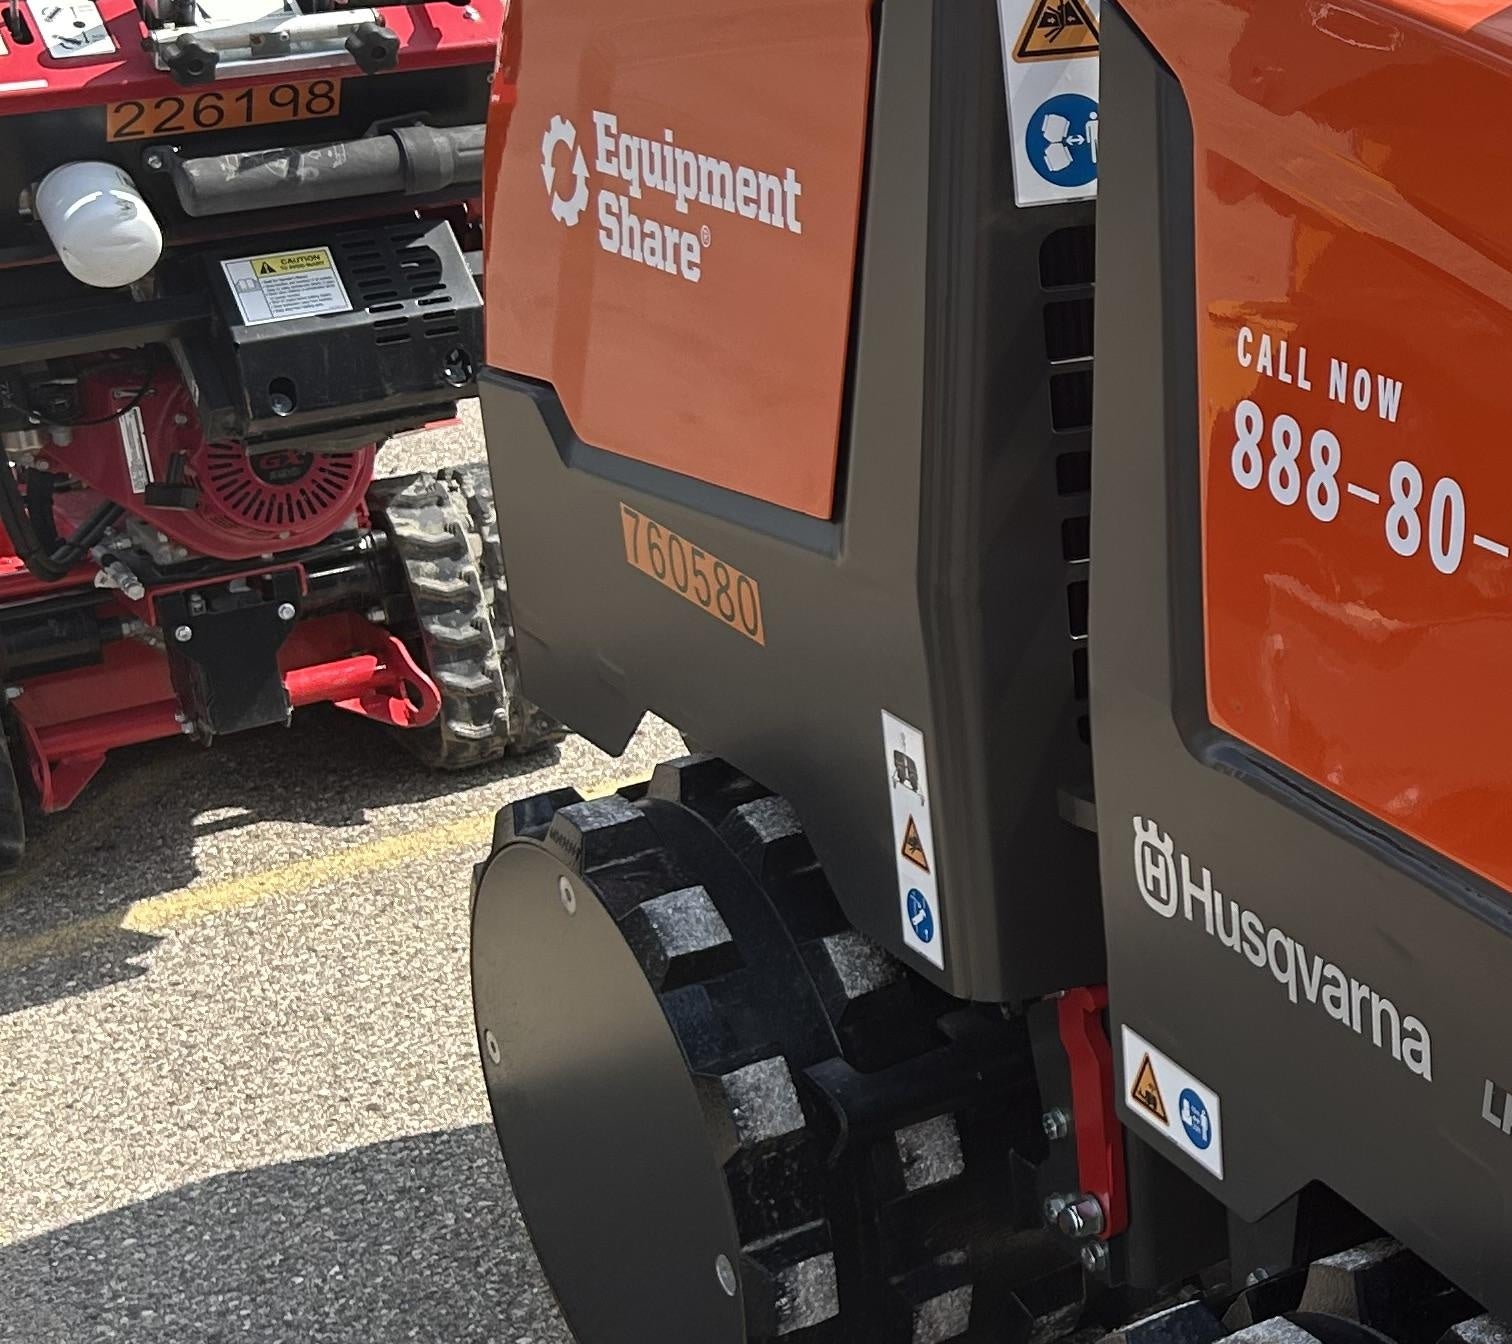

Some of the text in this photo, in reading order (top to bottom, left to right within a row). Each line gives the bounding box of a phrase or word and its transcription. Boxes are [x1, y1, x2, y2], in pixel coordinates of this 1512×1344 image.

[112, 79, 335, 138] 226198
[592, 110, 802, 234] Equipment
[280, 255, 321, 265] CAUTION
[1237, 326, 1403, 423] CALL NOW
[623, 507, 758, 638] 760580
[1181, 854, 1433, 1082] Husqvarna
